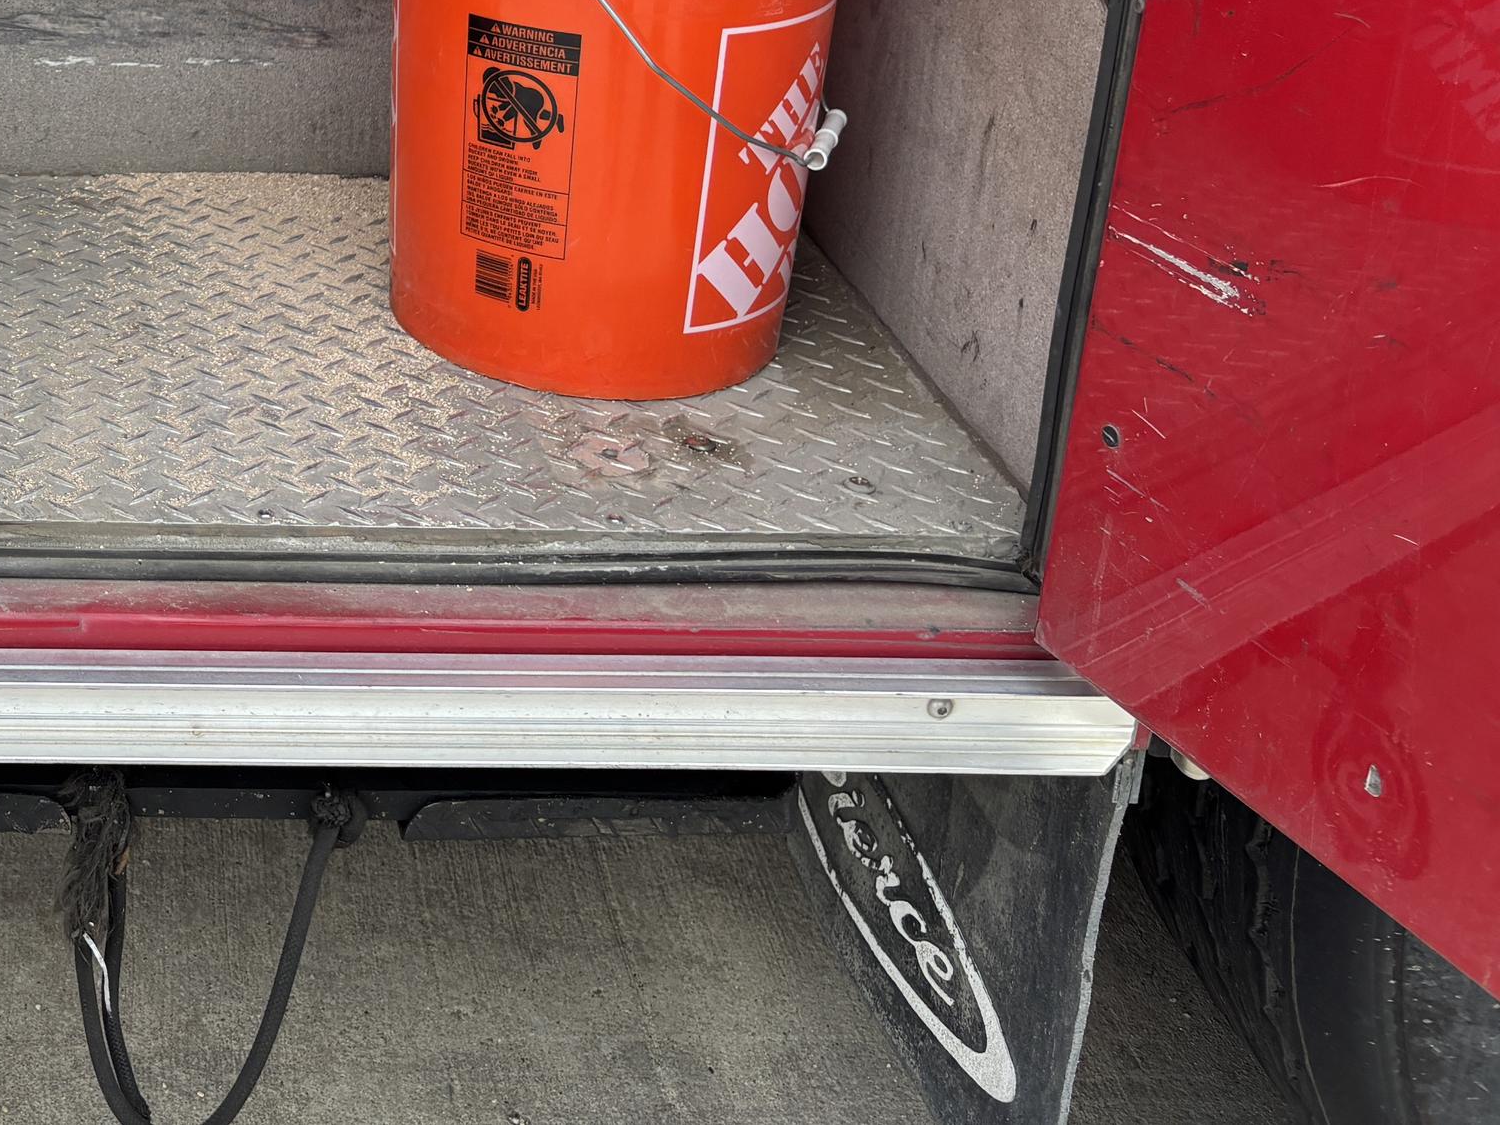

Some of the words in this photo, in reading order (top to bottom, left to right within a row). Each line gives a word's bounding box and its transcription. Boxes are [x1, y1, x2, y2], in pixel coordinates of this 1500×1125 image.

[502, 24, 554, 43] WARNING
[492, 36, 566, 59] ADVERTENCIA
[484, 48, 572, 74] AVERTISSEMENT
[738, 41, 823, 175] THE
[518, 262, 529, 307] LEAKTITE
